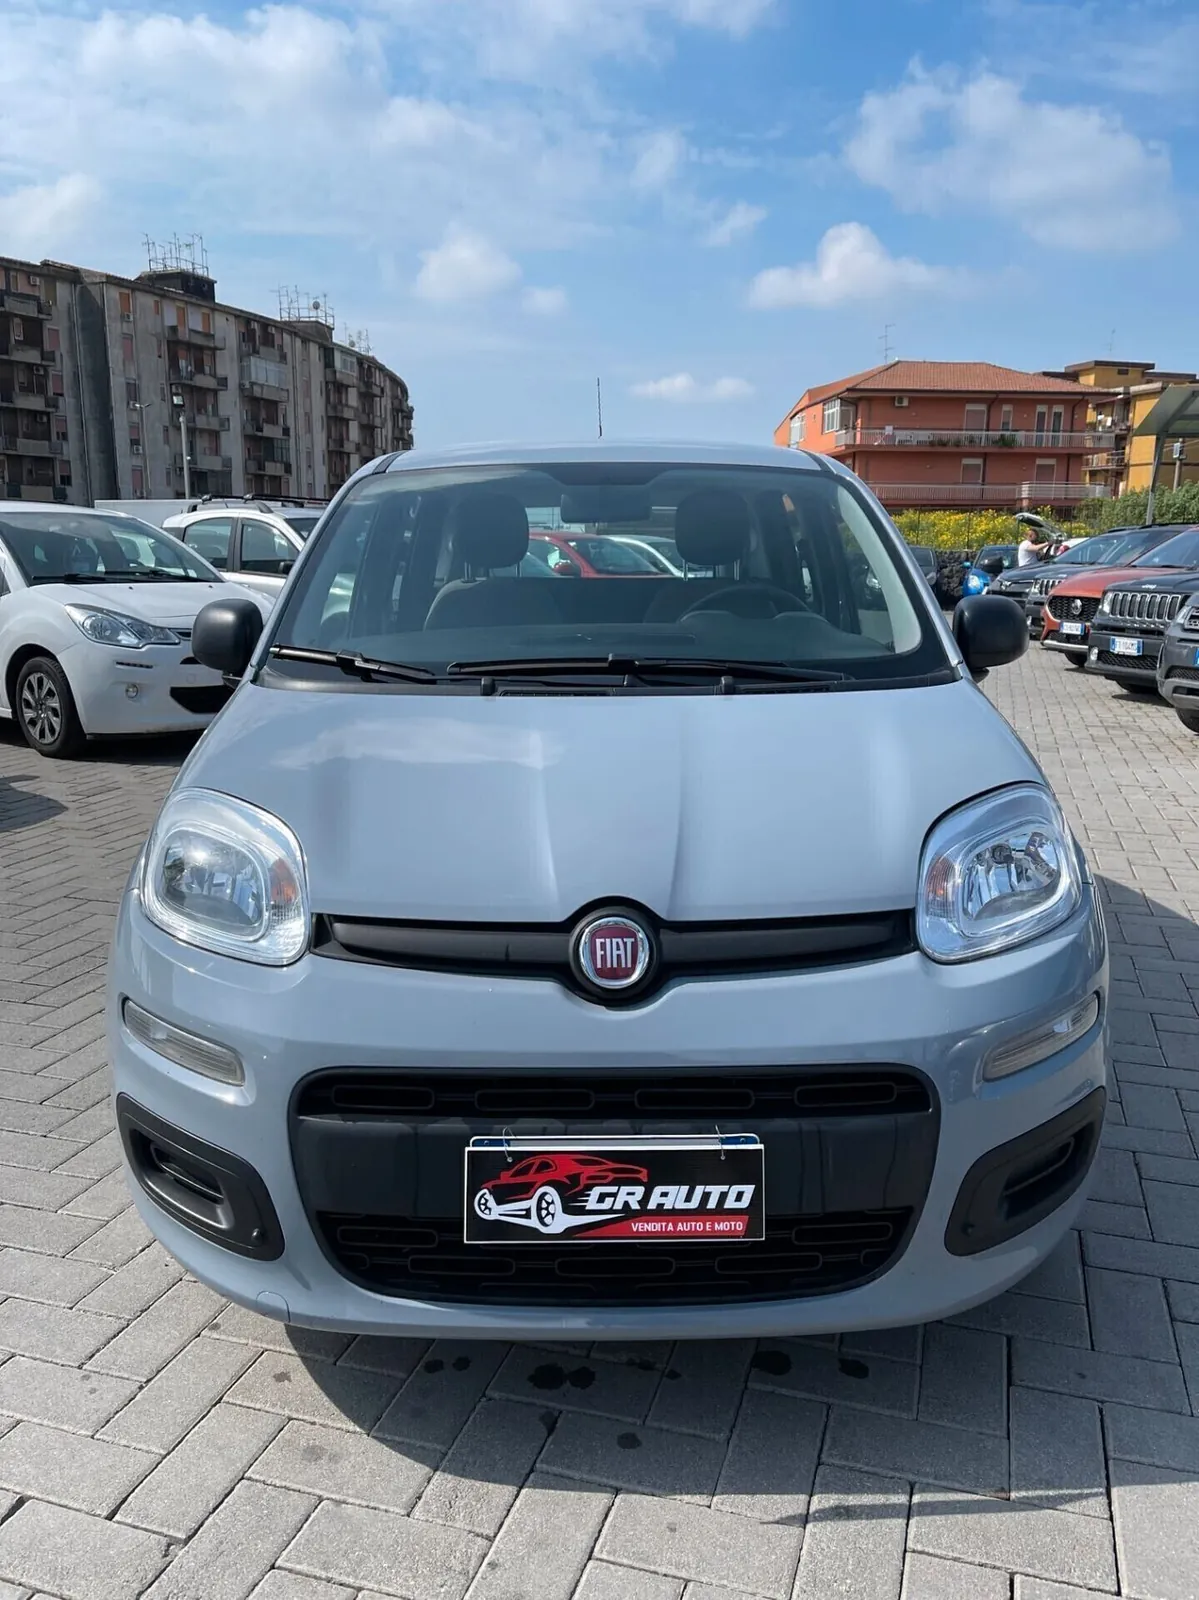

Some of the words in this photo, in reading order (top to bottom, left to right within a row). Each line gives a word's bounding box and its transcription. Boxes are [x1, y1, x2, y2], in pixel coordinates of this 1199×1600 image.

[595, 937, 635, 969] FIAT
[585, 1185, 646, 1210] GR
[647, 1184, 756, 1210] AUTO
[631, 1222, 674, 1232] VENDITA
[677, 1221, 704, 1232] AUTO
[706, 1221, 712, 1231] E
[714, 1221, 743, 1231] MOTO
